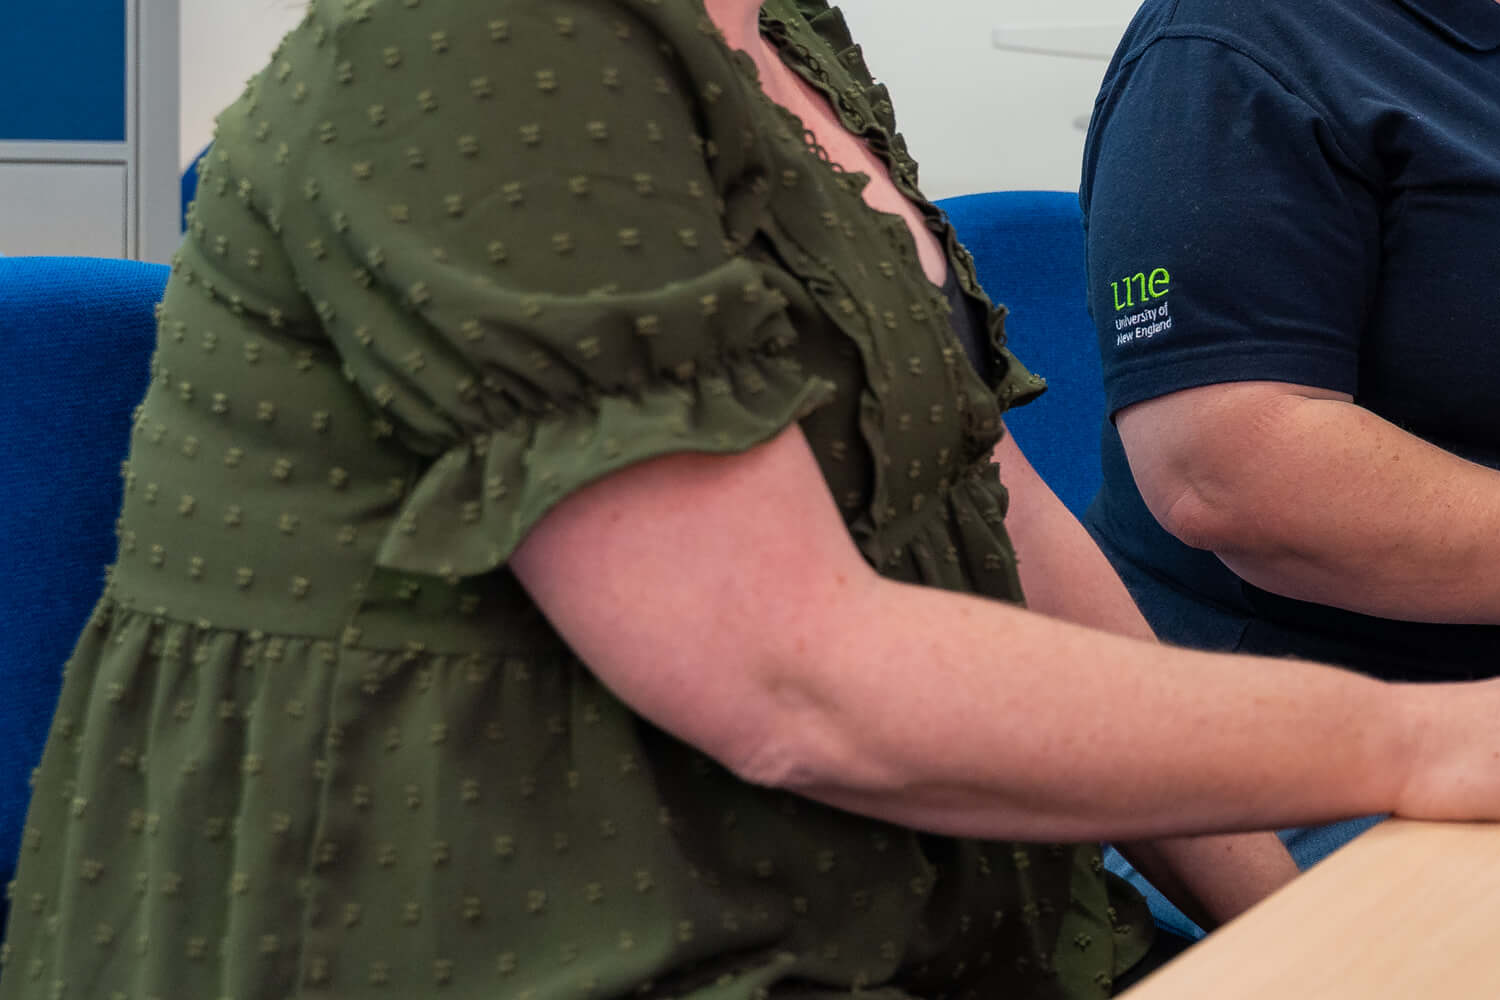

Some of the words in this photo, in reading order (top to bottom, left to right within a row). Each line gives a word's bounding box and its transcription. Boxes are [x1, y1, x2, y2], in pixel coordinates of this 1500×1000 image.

[1110, 267, 1170, 311] une
[1115, 307, 1157, 330] University
[1158, 301, 1169, 317] of
[1116, 330, 1134, 346] New
[1135, 315, 1172, 338] England
